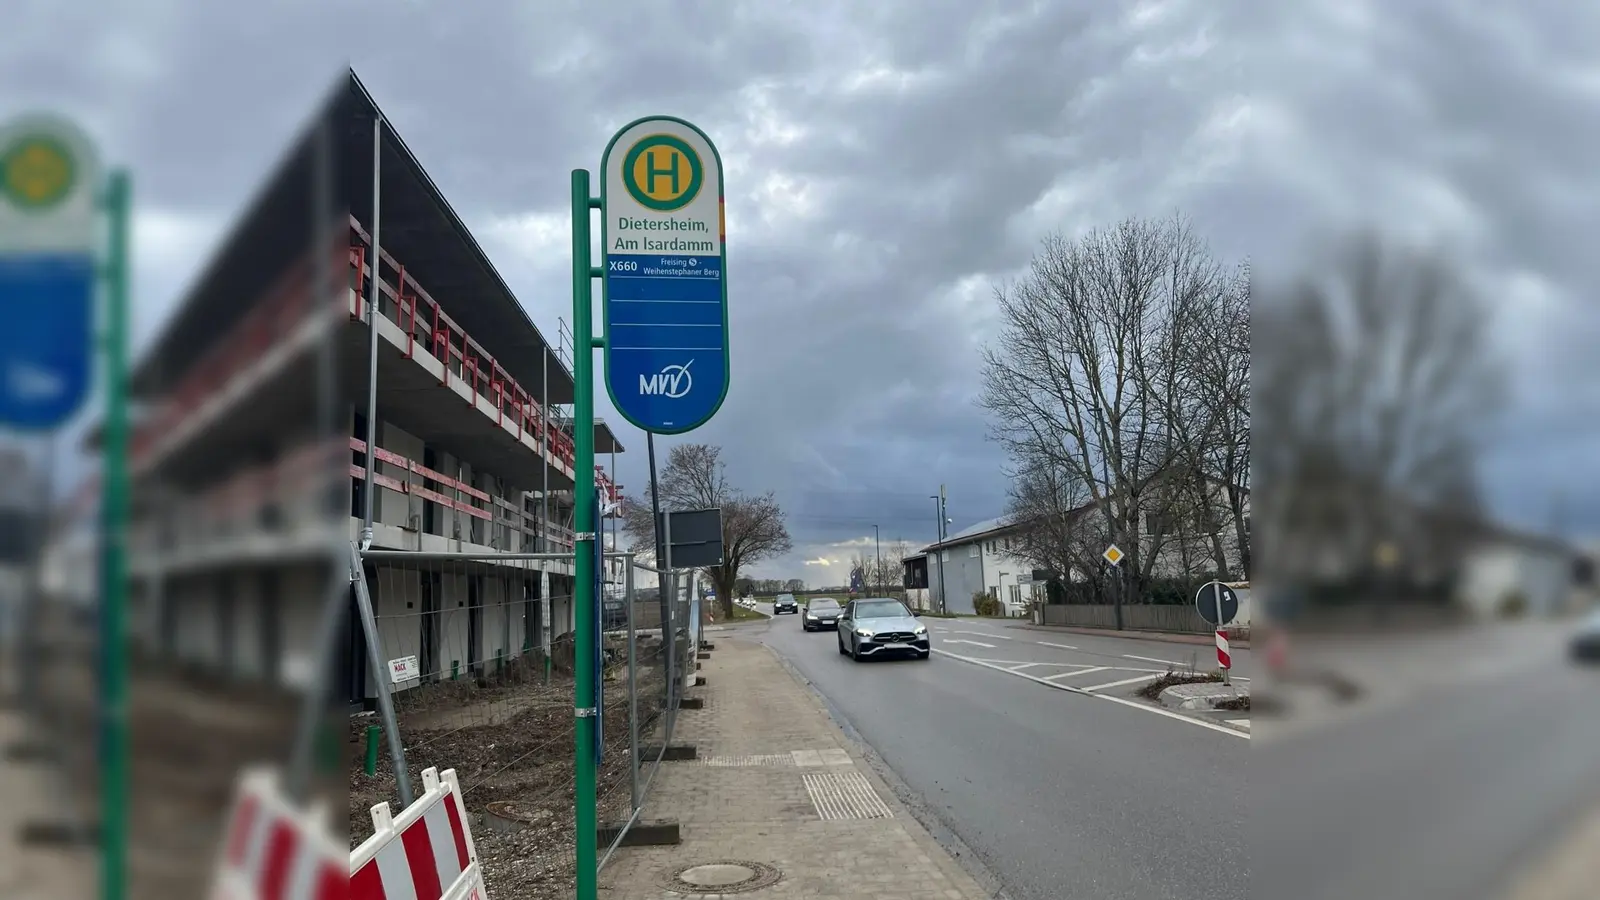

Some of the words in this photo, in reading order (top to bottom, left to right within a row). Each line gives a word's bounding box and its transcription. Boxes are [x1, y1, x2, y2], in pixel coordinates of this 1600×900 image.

[618, 217, 709, 233] Dietersheim,
[614, 237, 638, 250] Am
[644, 237, 713, 251] Isardamm
[609, 261, 638, 272] X660
[660, 258, 687, 267] Freising
[643, 268, 702, 276] Weihenstephaner
[703, 269, 720, 278] Berg
